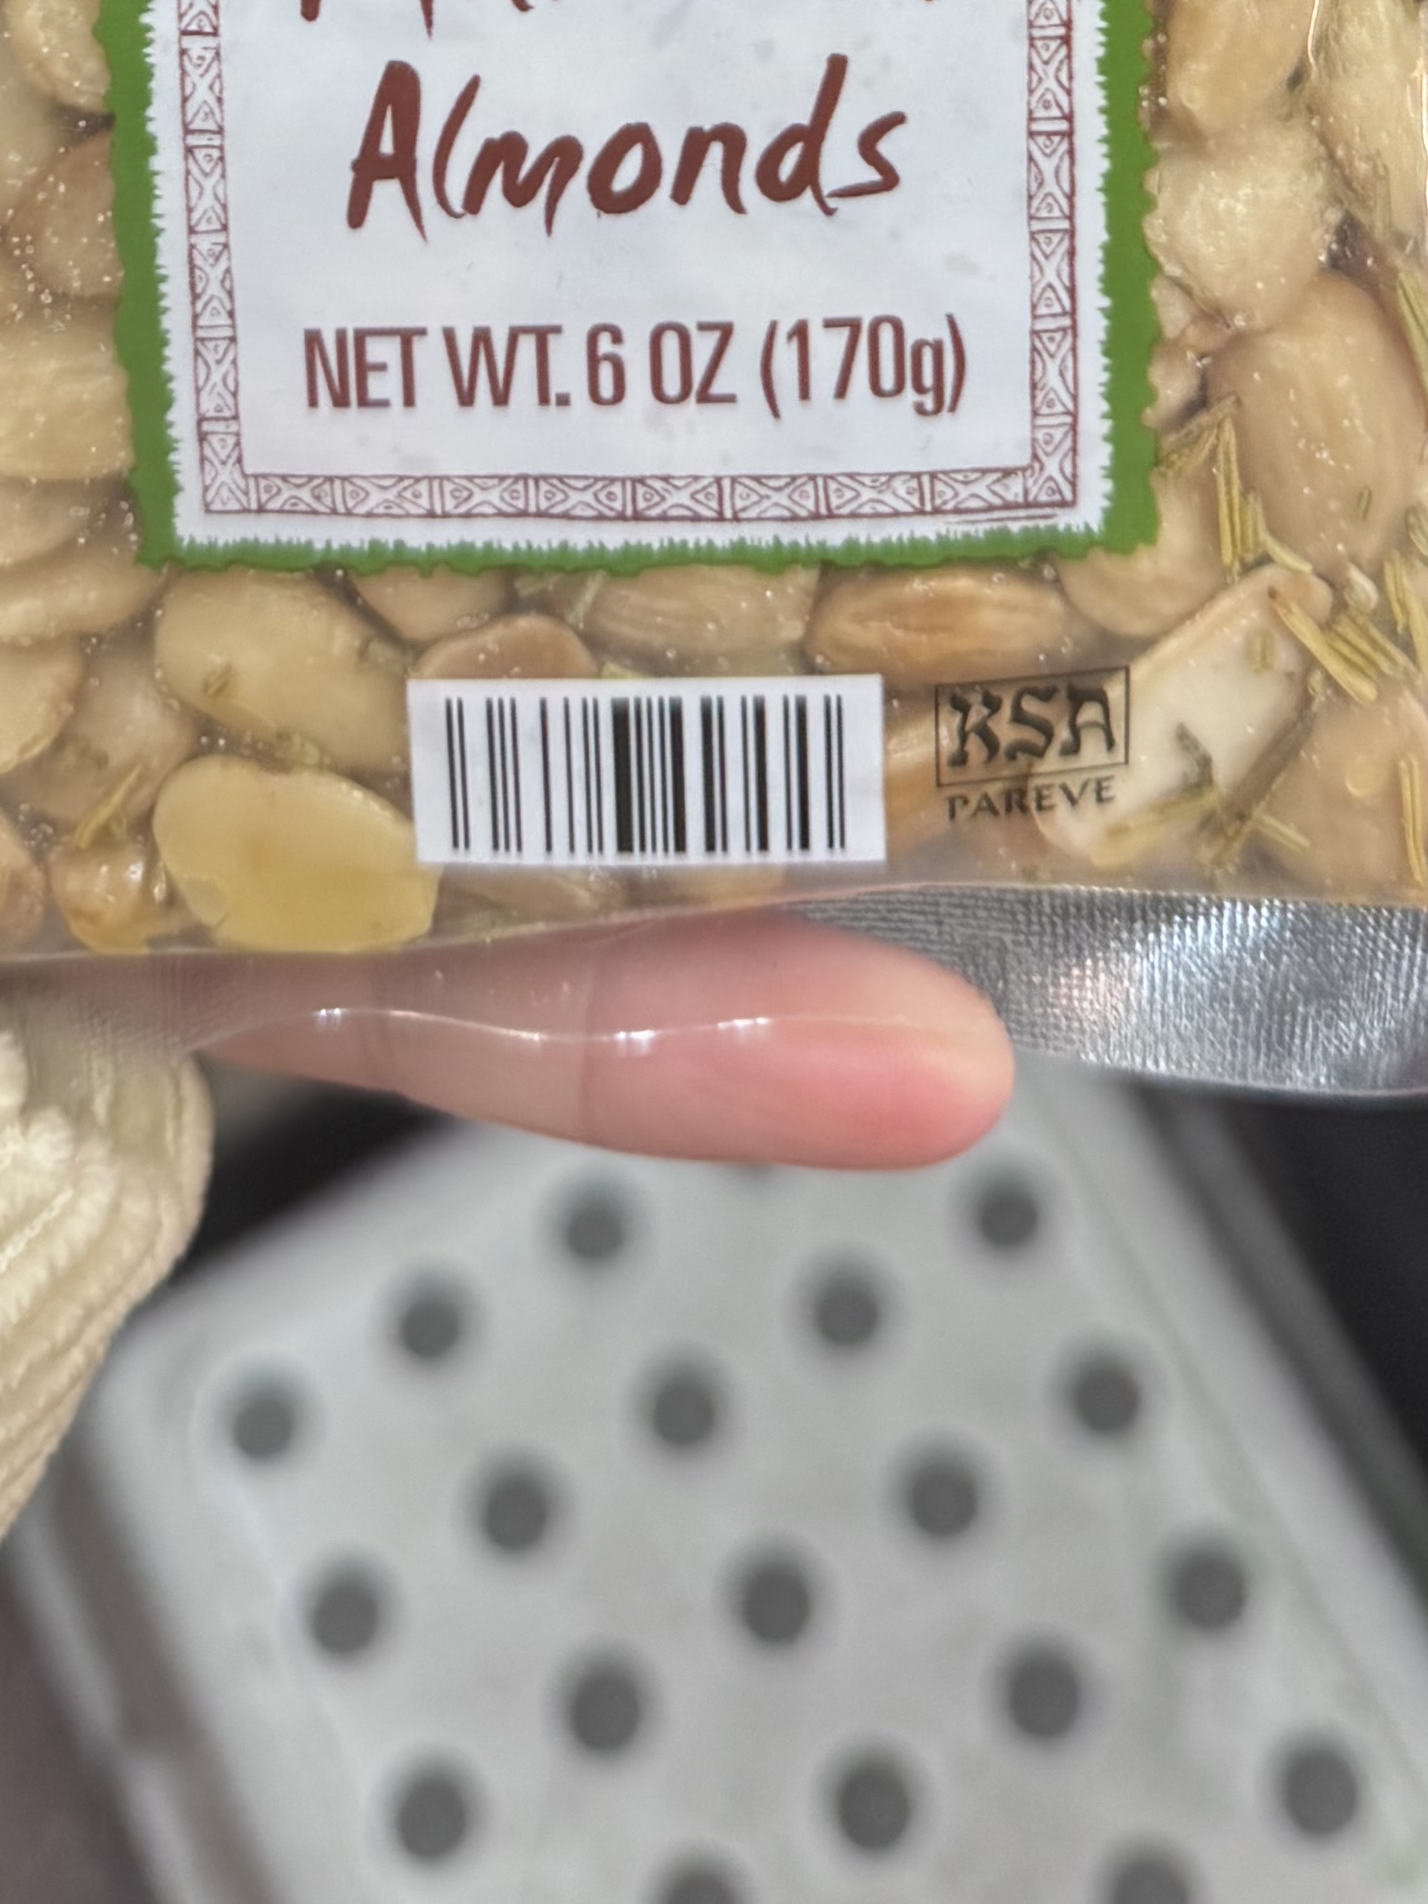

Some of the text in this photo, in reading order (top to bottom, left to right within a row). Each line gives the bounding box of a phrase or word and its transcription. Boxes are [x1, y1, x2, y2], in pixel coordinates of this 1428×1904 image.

[345, 53, 908, 242] Almonds
[303, 314, 968, 421] NET WT. 6 OZ (170g)
[945, 775, 1117, 822] PAREVE
